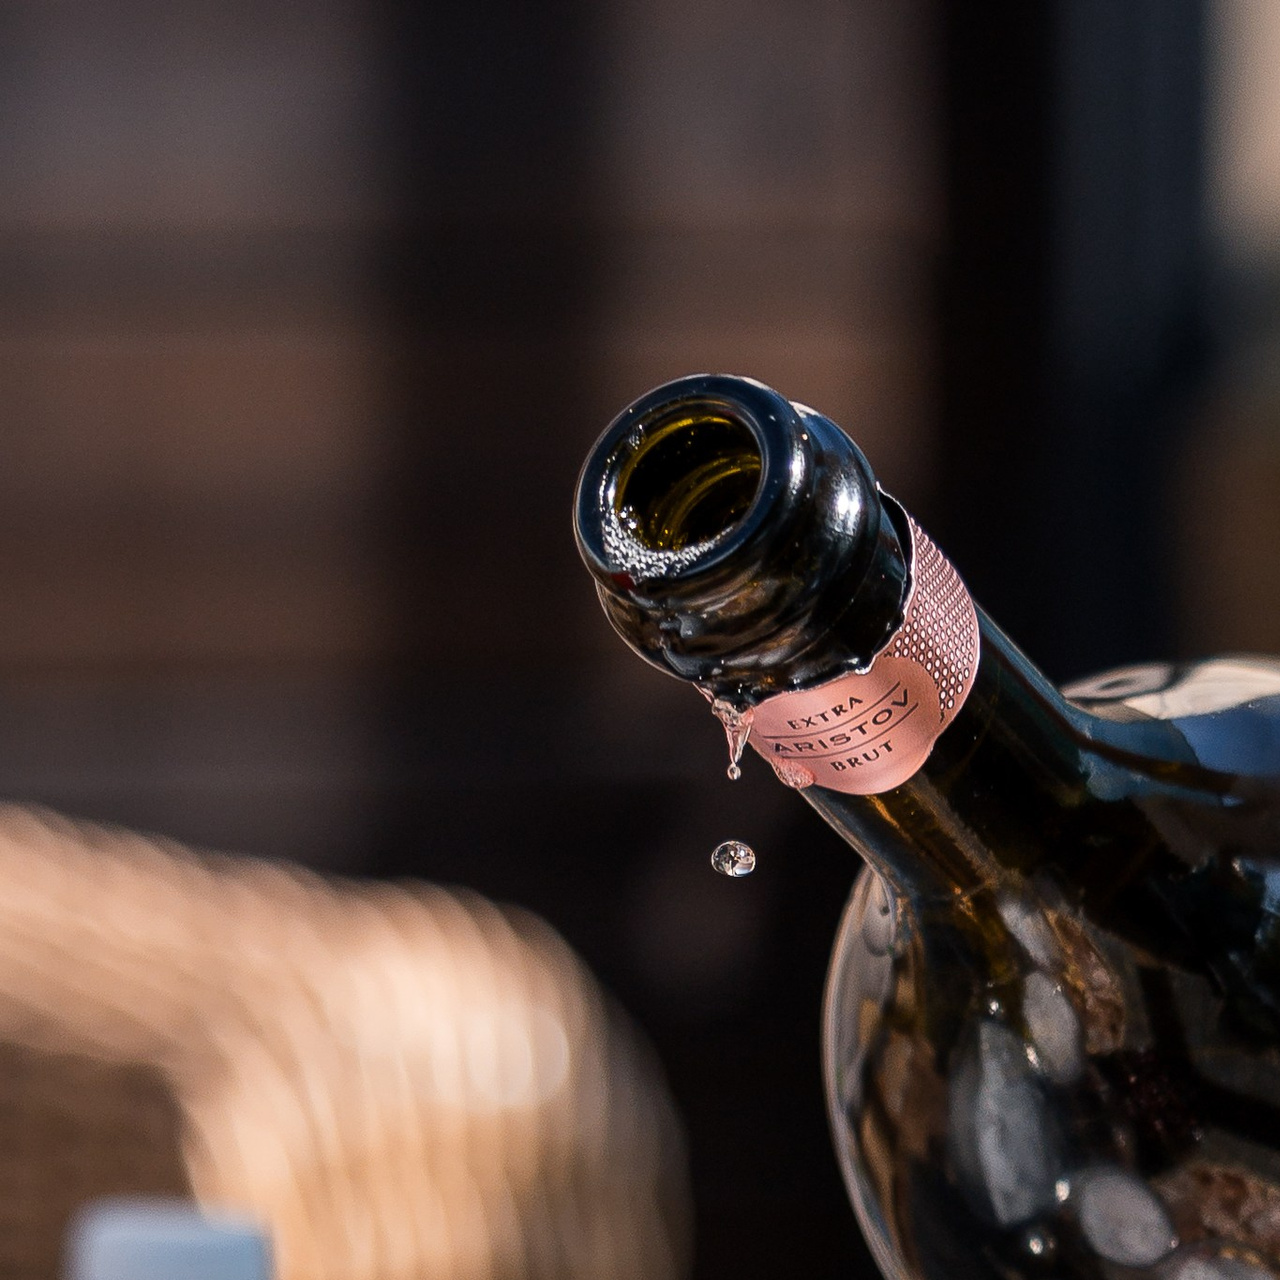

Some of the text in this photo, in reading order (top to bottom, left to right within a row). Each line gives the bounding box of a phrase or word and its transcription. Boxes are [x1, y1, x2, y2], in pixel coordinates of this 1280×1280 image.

[774, 689, 909, 754] ARISTOV
[787, 696, 863, 730] EXTRA
[830, 740, 894, 772] BRUT
